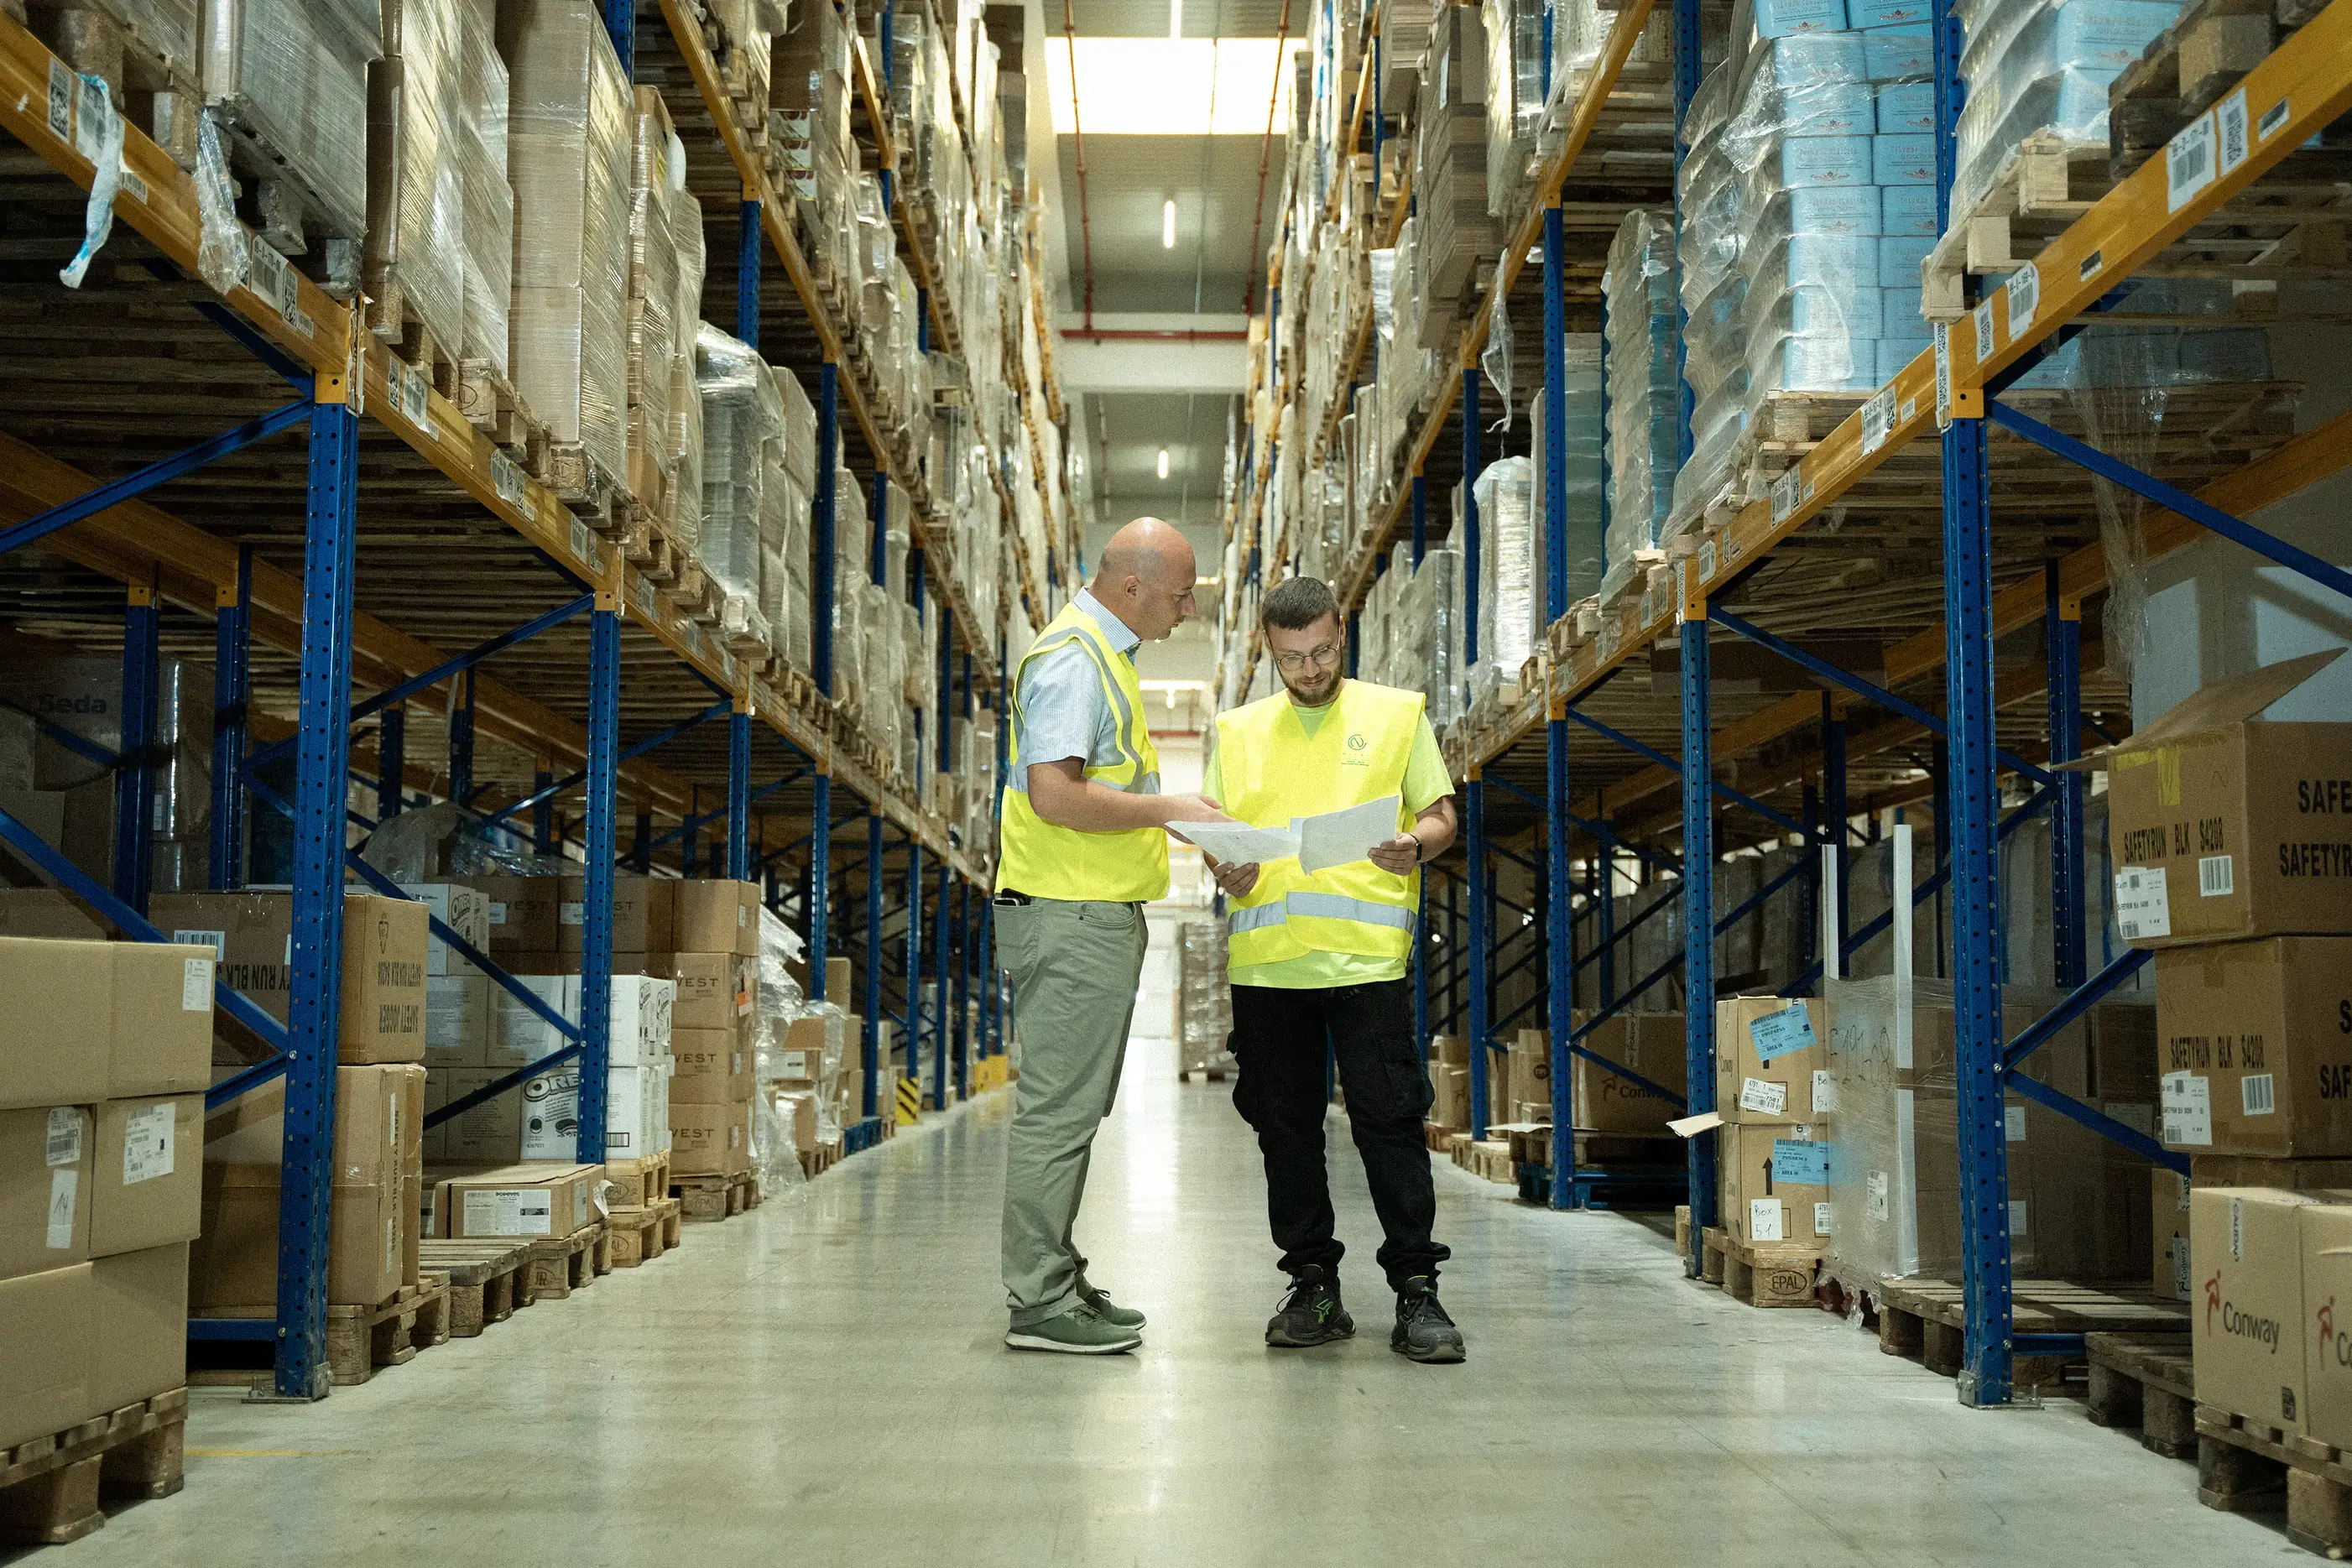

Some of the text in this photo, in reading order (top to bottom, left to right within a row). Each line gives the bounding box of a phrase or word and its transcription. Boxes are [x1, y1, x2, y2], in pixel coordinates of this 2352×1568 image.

[2298, 779, 2352, 814] SAFE
[2125, 816, 2224, 864] SAFETYRUN BLK S4208
[227, 964, 249, 991] BLK
[251, 964, 276, 990] RUN
[2170, 1036, 2210, 1070] SAFETYRUN
[2218, 1035, 2233, 1069] BLK
[1755, 1204, 1773, 1217] Box
[1771, 1275, 1802, 1289] EPAL
[2224, 1300, 2280, 1354] Conway
